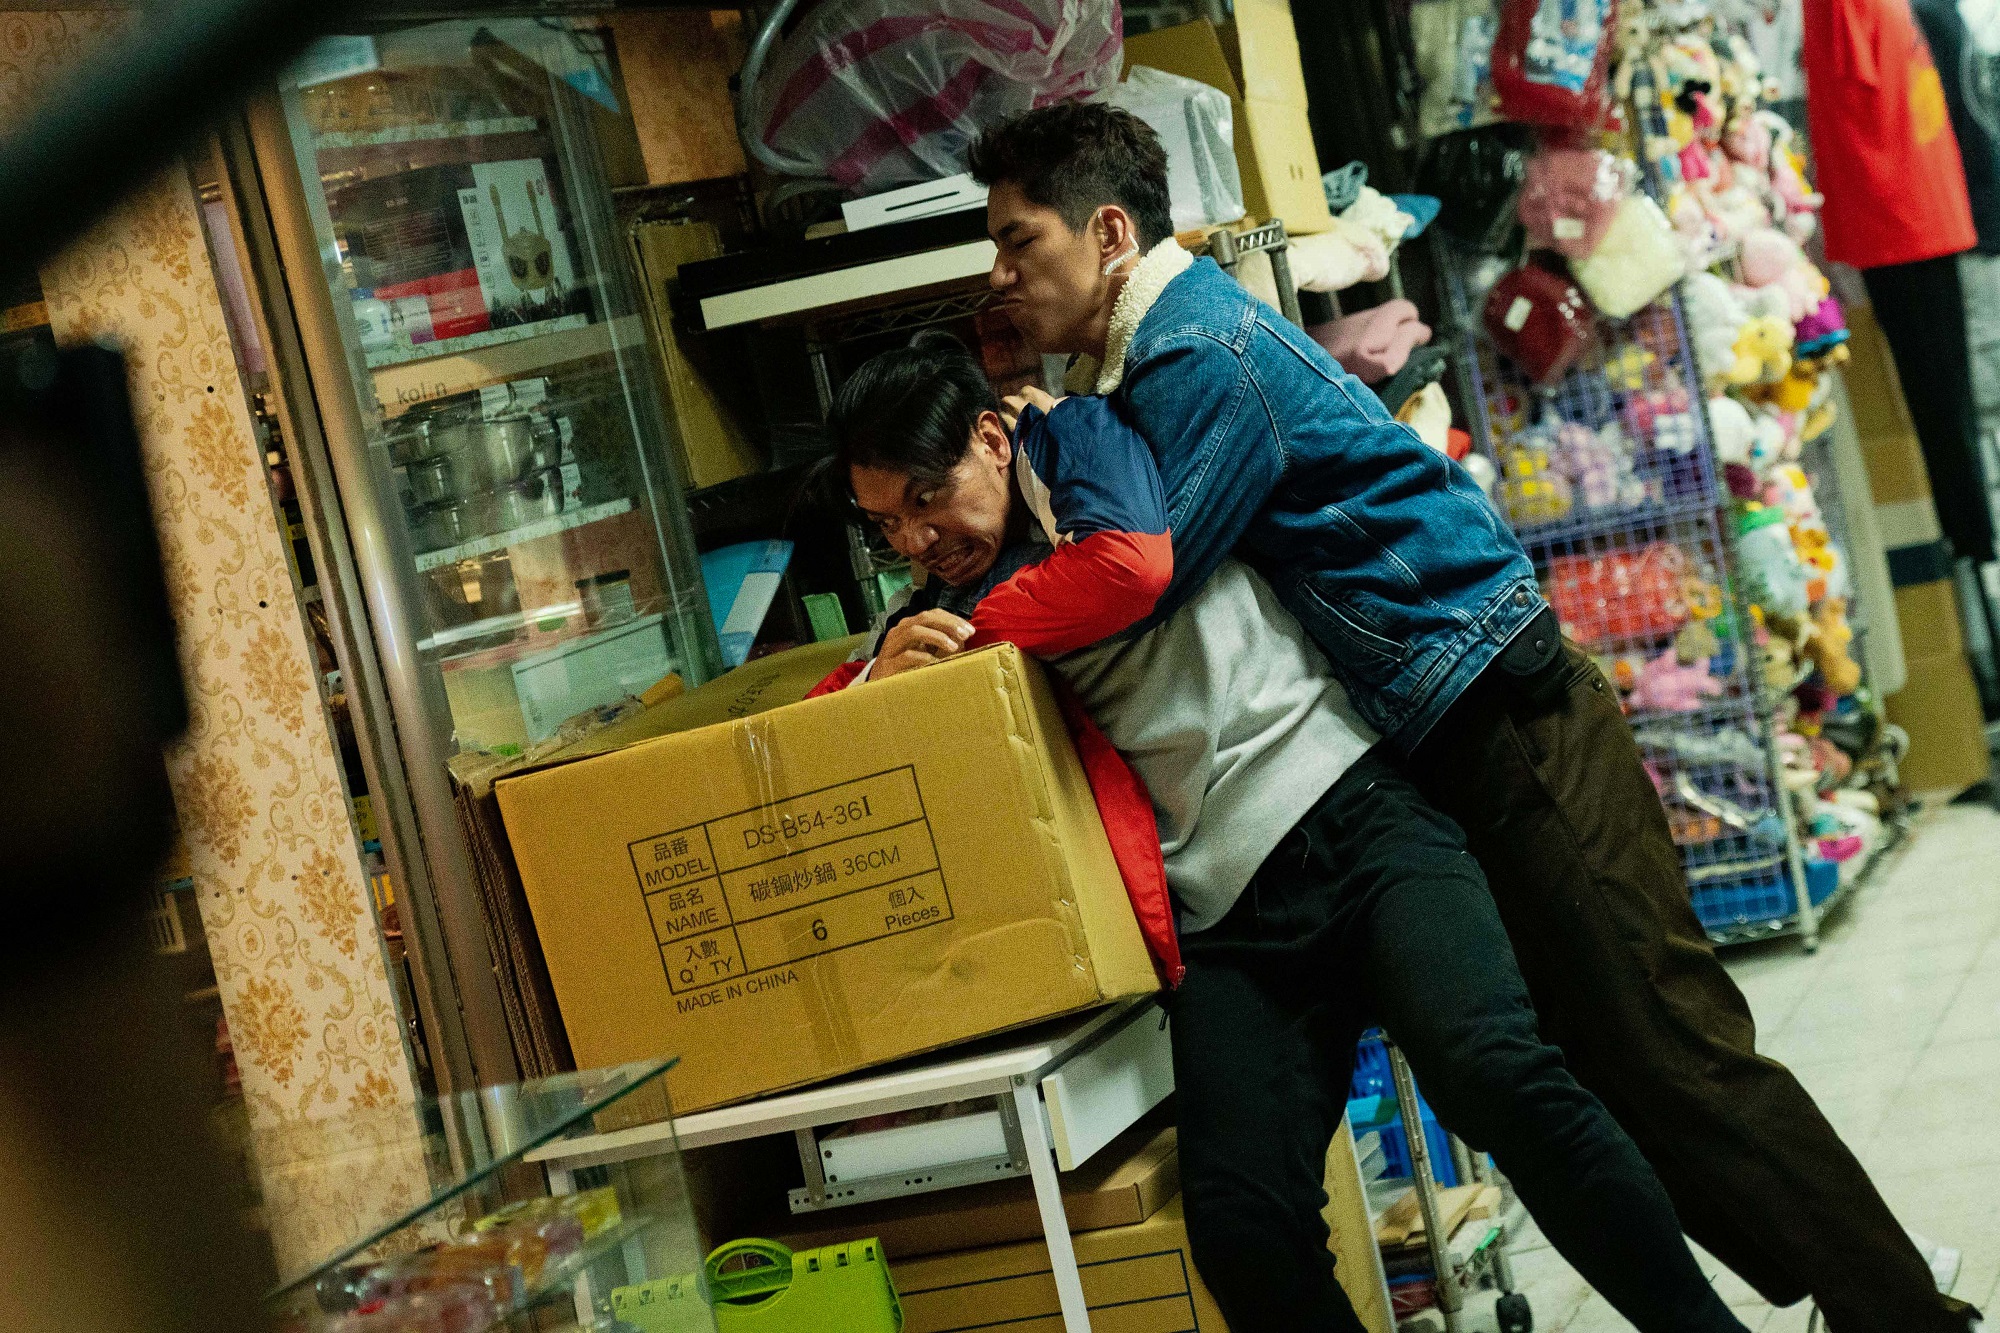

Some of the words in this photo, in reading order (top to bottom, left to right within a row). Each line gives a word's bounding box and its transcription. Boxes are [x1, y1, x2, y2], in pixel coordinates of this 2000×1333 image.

[654, 835, 689, 862] 品番
[645, 858, 710, 887] MODEL
[748, 862, 838, 903] 碳鋼炒鍋
[842, 845, 901, 877] 36CM
[669, 888, 704, 912] 品名
[888, 886, 925, 909] 個入
[665, 907, 720, 934] NAME
[812, 919, 828, 941] 6
[885, 905, 941, 930] Pieces
[685, 939, 720, 963] 入數
[676, 989, 723, 1014] MADE
[725, 984, 743, 1000] IN
[745, 969, 800, 994] CHINA
